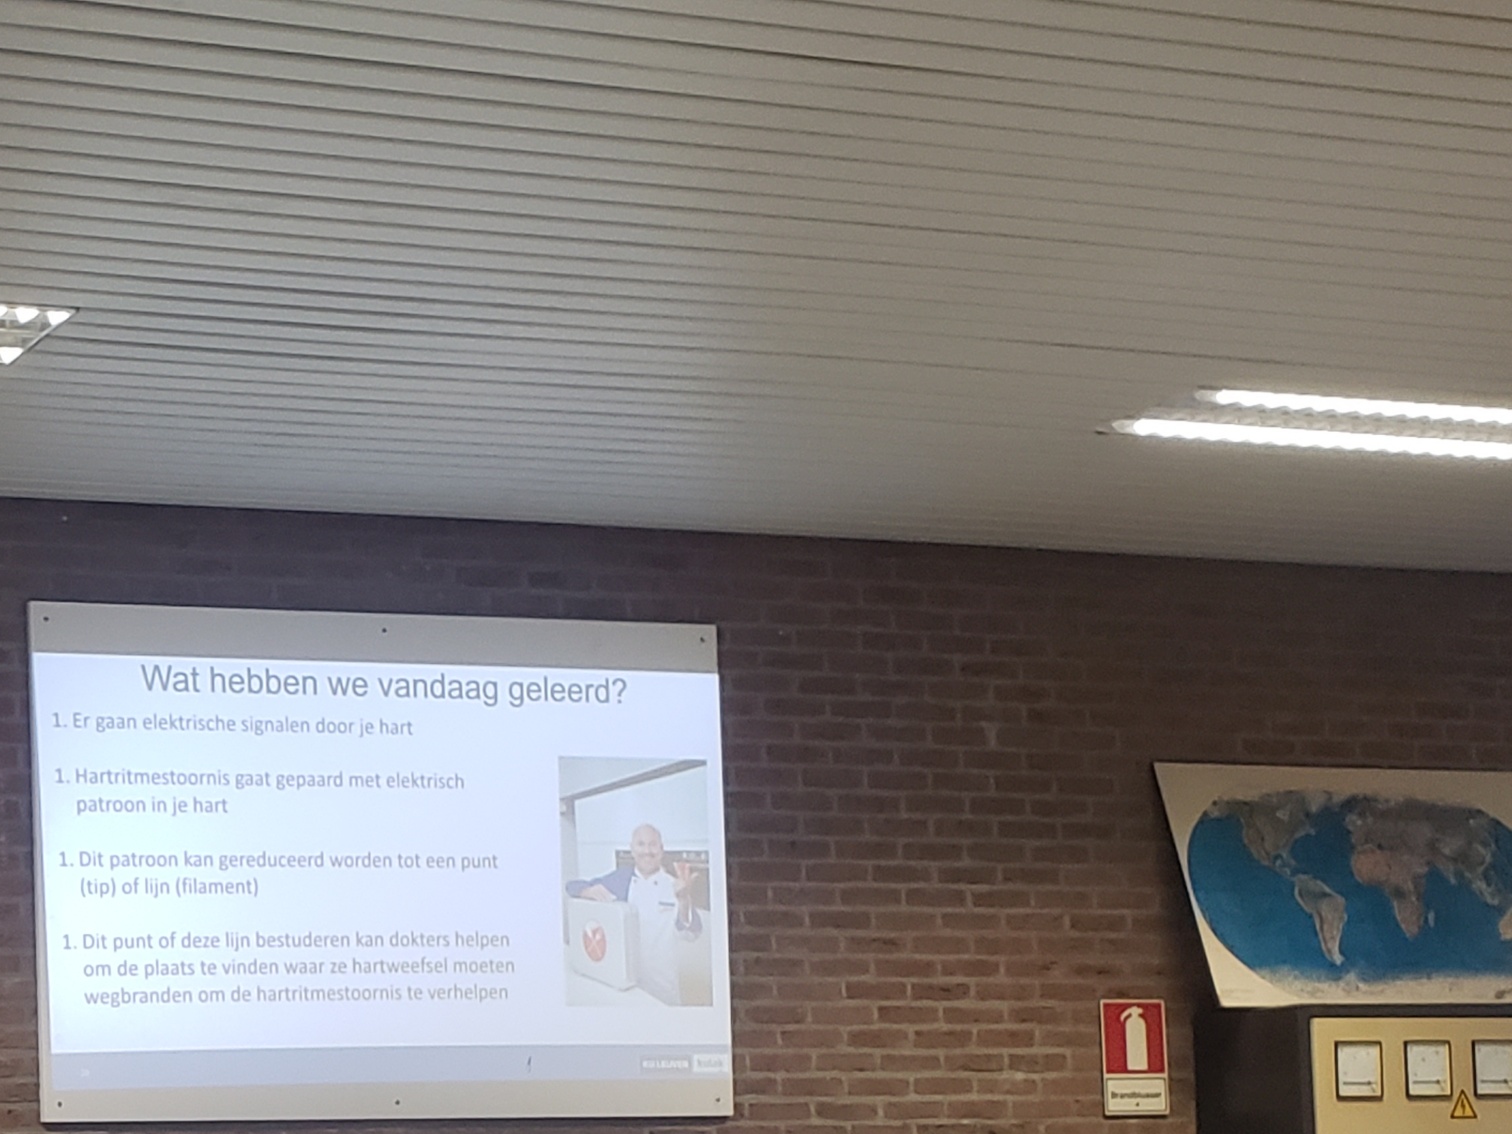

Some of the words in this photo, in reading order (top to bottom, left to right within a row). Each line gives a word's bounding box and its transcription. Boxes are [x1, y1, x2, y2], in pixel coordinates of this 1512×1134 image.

[141, 664, 200, 693] Wat
[210, 666, 317, 695] hebben
[327, 676, 368, 697] we
[377, 673, 498, 707] vandaag
[509, 672, 628, 707] geleerd?
[52, 712, 68, 728] 1.
[73, 712, 91, 728] Er
[96, 716, 138, 733] gaan
[142, 712, 237, 732] elektrische
[241, 715, 311, 737] signalen
[315, 717, 355, 735] door
[358, 717, 376, 738] je
[379, 717, 413, 736] hart
[55, 768, 71, 784] 1.
[75, 768, 230, 786] Hartritmestoornis
[235, 772, 271, 790] gaat
[276, 770, 343, 791] gepaard
[349, 773, 381, 789] met
[386, 771, 464, 789] elektrisch
[76, 797, 146, 816] patroon
[151, 796, 167, 813] in
[171, 796, 188, 817] je
[192, 795, 228, 813] hart
[59, 851, 74, 867] 1.
[79, 851, 104, 868] Dit
[110, 852, 178, 871] patroon
[184, 850, 214, 868] kan
[219, 850, 324, 872] gereduceerd
[329, 851, 392, 868] worden
[397, 853, 421, 869] tot
[426, 856, 456, 869] een
[461, 854, 498, 873] punt
[81, 877, 116, 898] (tip)
[122, 877, 139, 894] of
[145, 877, 170, 898] lijn
[175, 876, 258, 898] (filament)
[63, 934, 78, 950] 1.
[83, 933, 108, 951] Dit
[113, 934, 154, 953] punt
[158, 931, 178, 950] of
[181, 931, 222, 950] deze
[225, 931, 252, 953] lijn
[254, 931, 351, 949] bestuderen
[355, 931, 385, 949] kan
[389, 930, 451, 948] dokters
[455, 930, 510, 951] helpen
[83, 964, 111, 977] om
[117, 960, 139, 976] de
[144, 958, 195, 980] plaats
[200, 960, 217, 976] te
[221, 957, 279, 976] vinden
[283, 961, 325, 975] waar
[330, 961, 347, 975] ze
[352, 957, 449, 976] hartweefsel
[453, 959, 515, 976] moeten
[84, 985, 193, 1008] wegbranden
[198, 990, 225, 1003] om
[231, 984, 252, 1002] de
[256, 981, 403, 1002] hartritmestoornis
[407, 985, 423, 1001] te
[427, 982, 508, 1003] verhelpen
